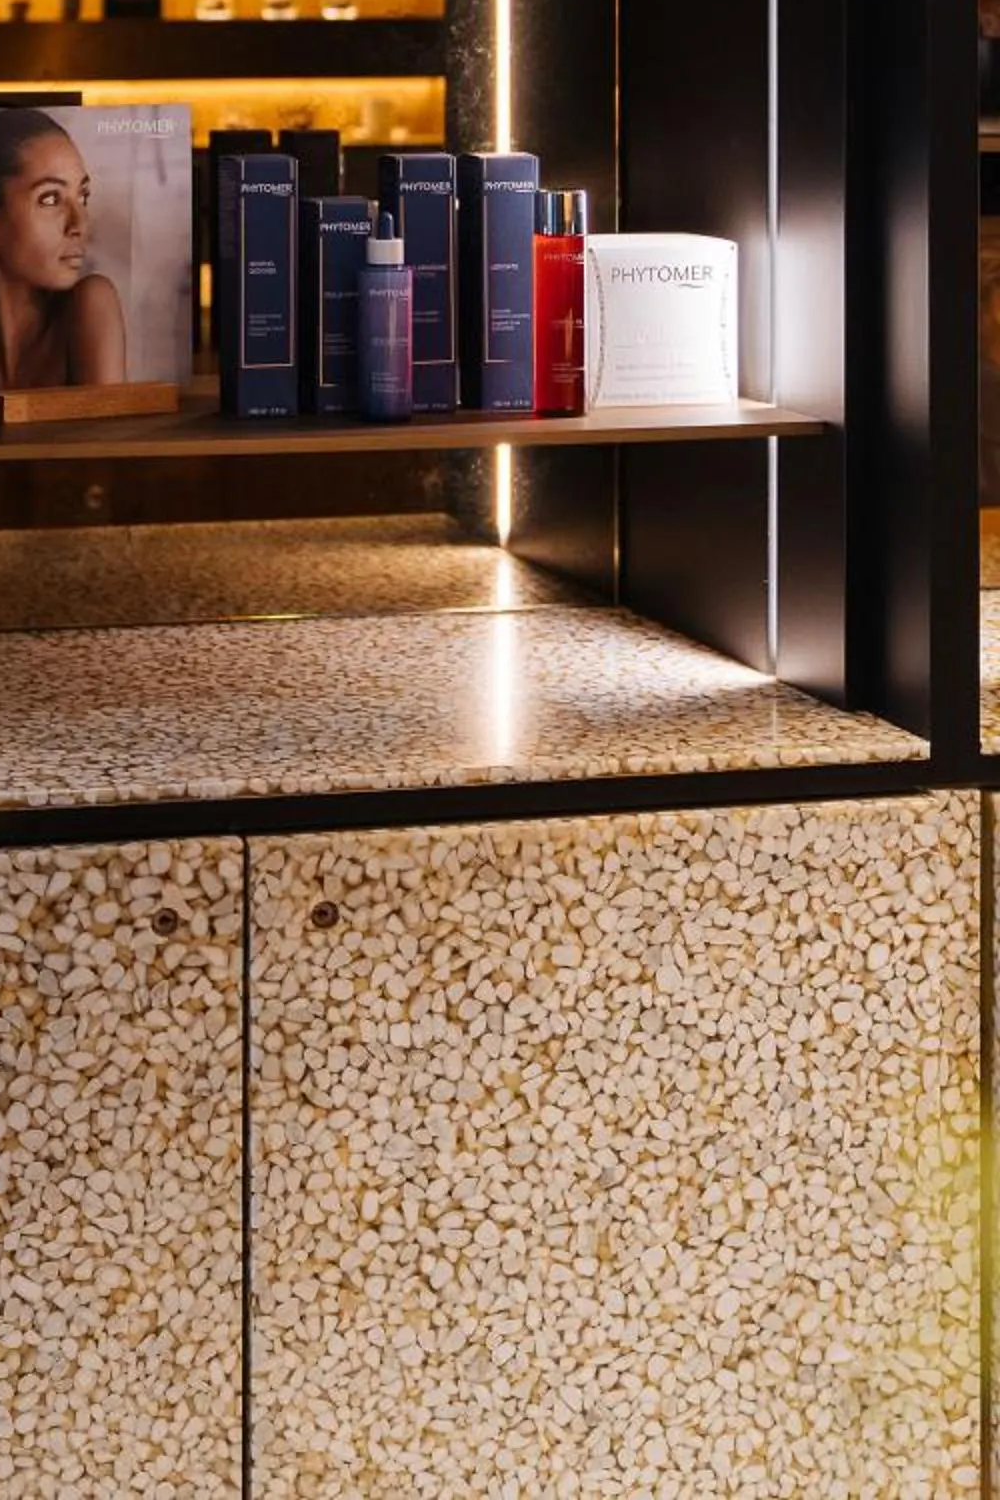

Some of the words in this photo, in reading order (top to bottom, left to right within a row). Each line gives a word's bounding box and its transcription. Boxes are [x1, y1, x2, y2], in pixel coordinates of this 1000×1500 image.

[96, 118, 175, 135] PHYTOMER
[240, 182, 293, 194] PHYTOMER
[400, 180, 452, 192] PHYTOMER
[484, 180, 535, 191] PHYTOMER
[320, 220, 371, 232] PHYTOMER
[610, 265, 714, 284] PHYTOMER
